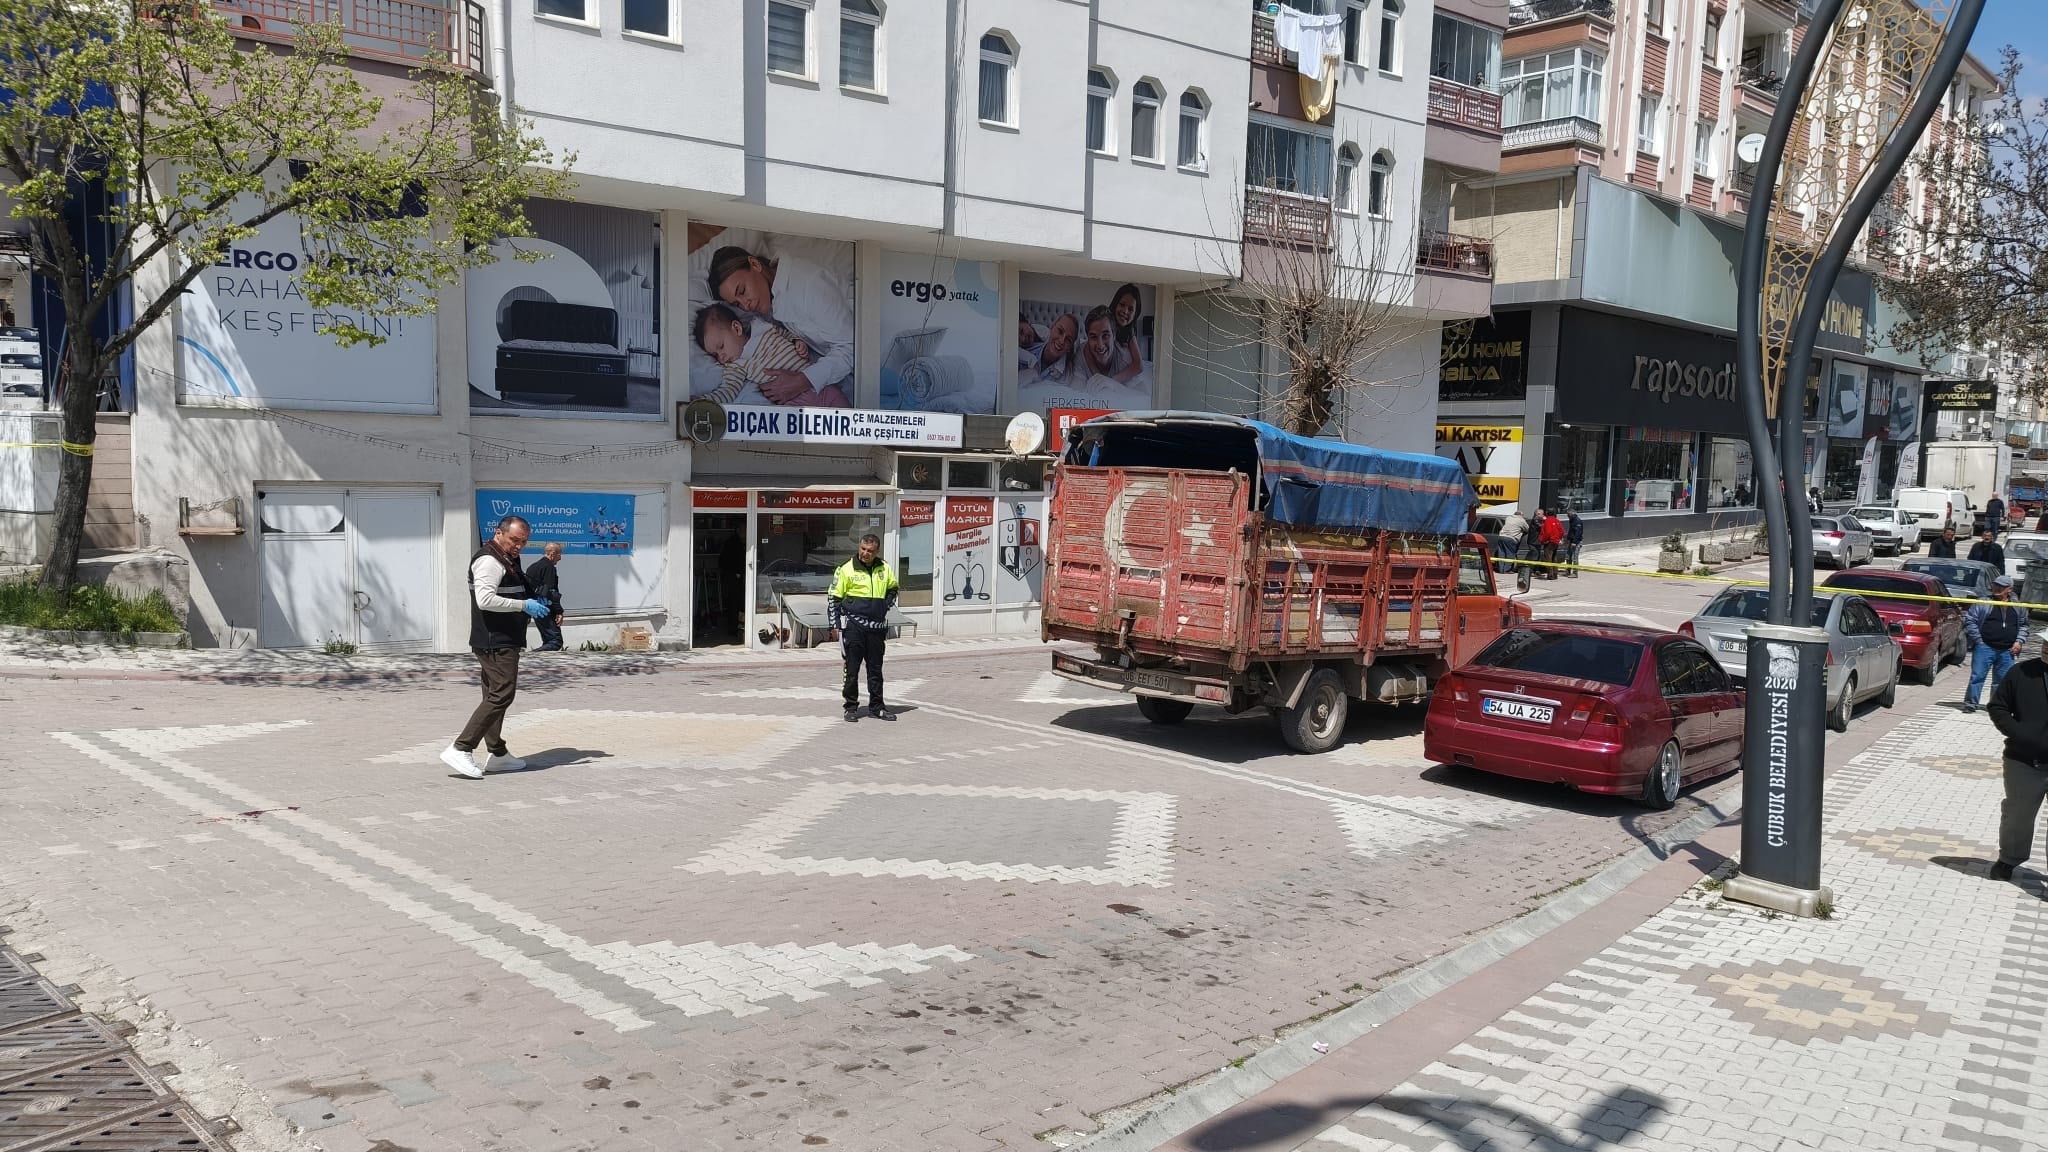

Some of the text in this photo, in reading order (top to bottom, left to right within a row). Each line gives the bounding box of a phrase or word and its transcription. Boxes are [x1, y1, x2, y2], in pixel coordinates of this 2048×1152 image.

[214, 247, 298, 272] ERGO
[890, 279, 979, 303] ergo yatak
[1830, 300, 1863, 338] HOME
[1473, 340, 1522, 358] HOME
[1630, 355, 1737, 404] rapsodi
[1968, 392, 1992, 400] HOME
[727, 409, 851, 436] BIÇAK BİLENİR
[866, 414, 926, 427] MALZEMELERİ
[874, 428, 919, 441] ÇEŞİTLERİ
[1452, 426, 1512, 442] KARTSIZ
[1436, 446, 1497, 475] AY
[802, 497, 850, 505] MARKET
[952, 503, 987, 513] TÜTÜN
[513, 504, 579, 516] milli piyango
[905, 505, 930, 513] TÜTÜN
[902, 513, 934, 521] MARKET
[946, 515, 992, 524] MARKET
[956, 529, 982, 541] Nargile
[947, 536, 991, 552] Malzemeleri
[1764, 676, 1797, 690] 2020
[1489, 701, 1551, 721] 54 UA 225
[1767, 691, 1789, 847] ÇUBUK BELEDİYESİ
